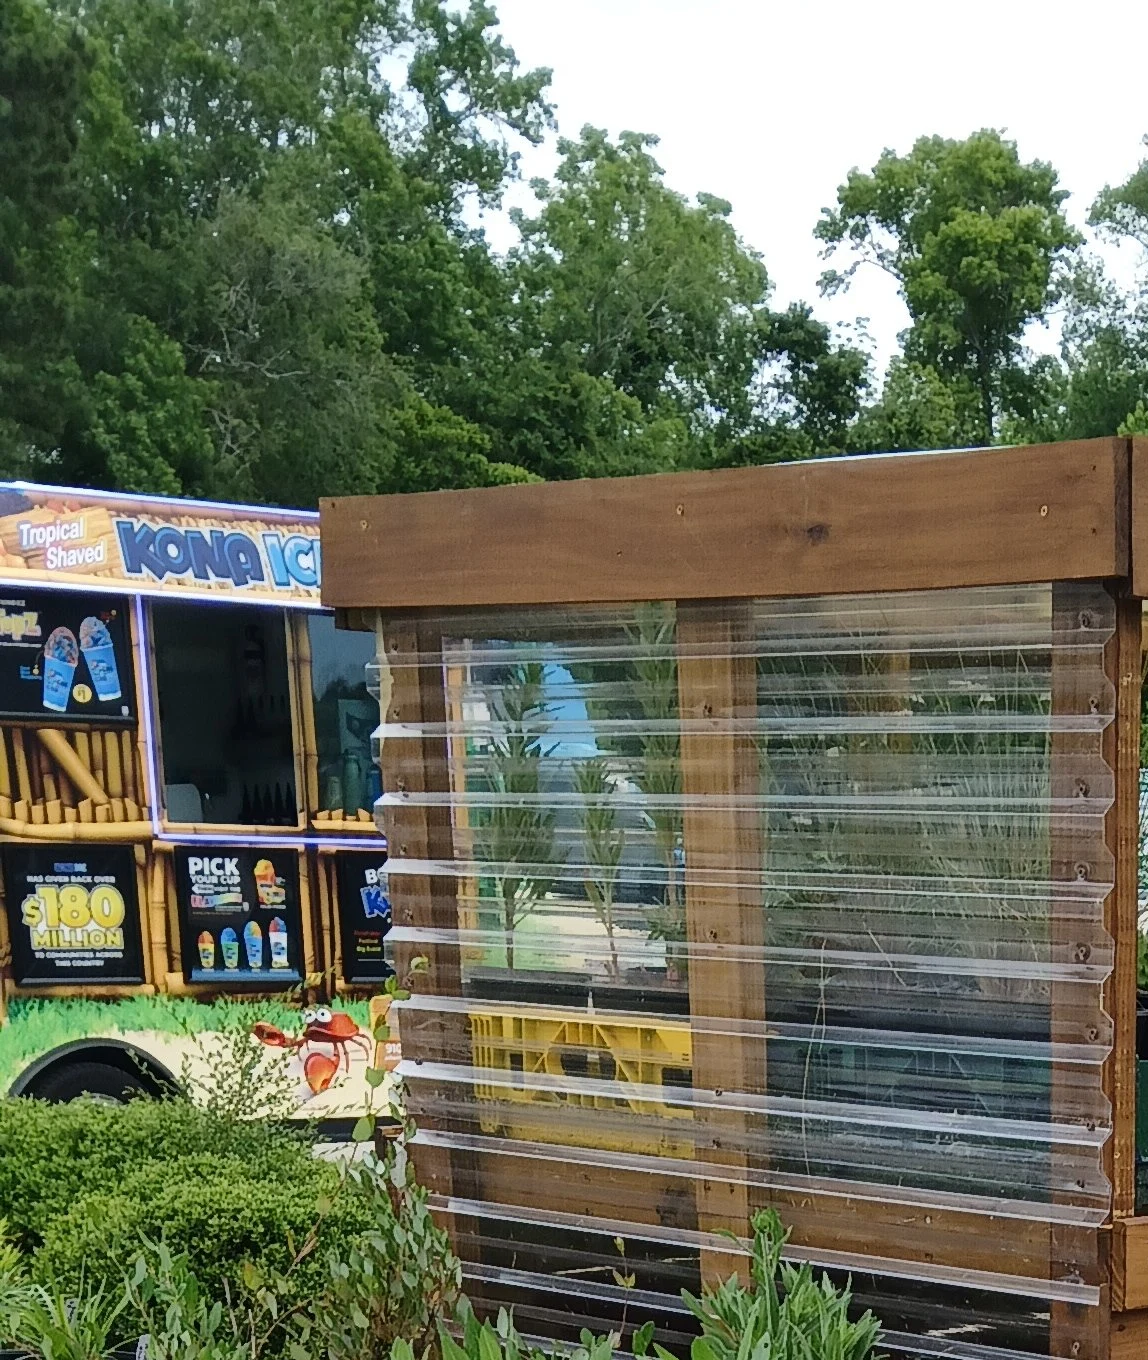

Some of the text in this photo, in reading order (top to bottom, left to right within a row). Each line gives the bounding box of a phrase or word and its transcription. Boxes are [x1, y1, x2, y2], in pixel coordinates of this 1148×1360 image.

[19, 517, 85, 548] Tropical
[46, 541, 105, 570] Shaved
[115, 519, 322, 588] KONA IC
[188, 856, 240, 876] PICK
[190, 874, 241, 885] YOUR CUP
[21, 884, 126, 929] $180
[30, 928, 124, 950] MILLION
